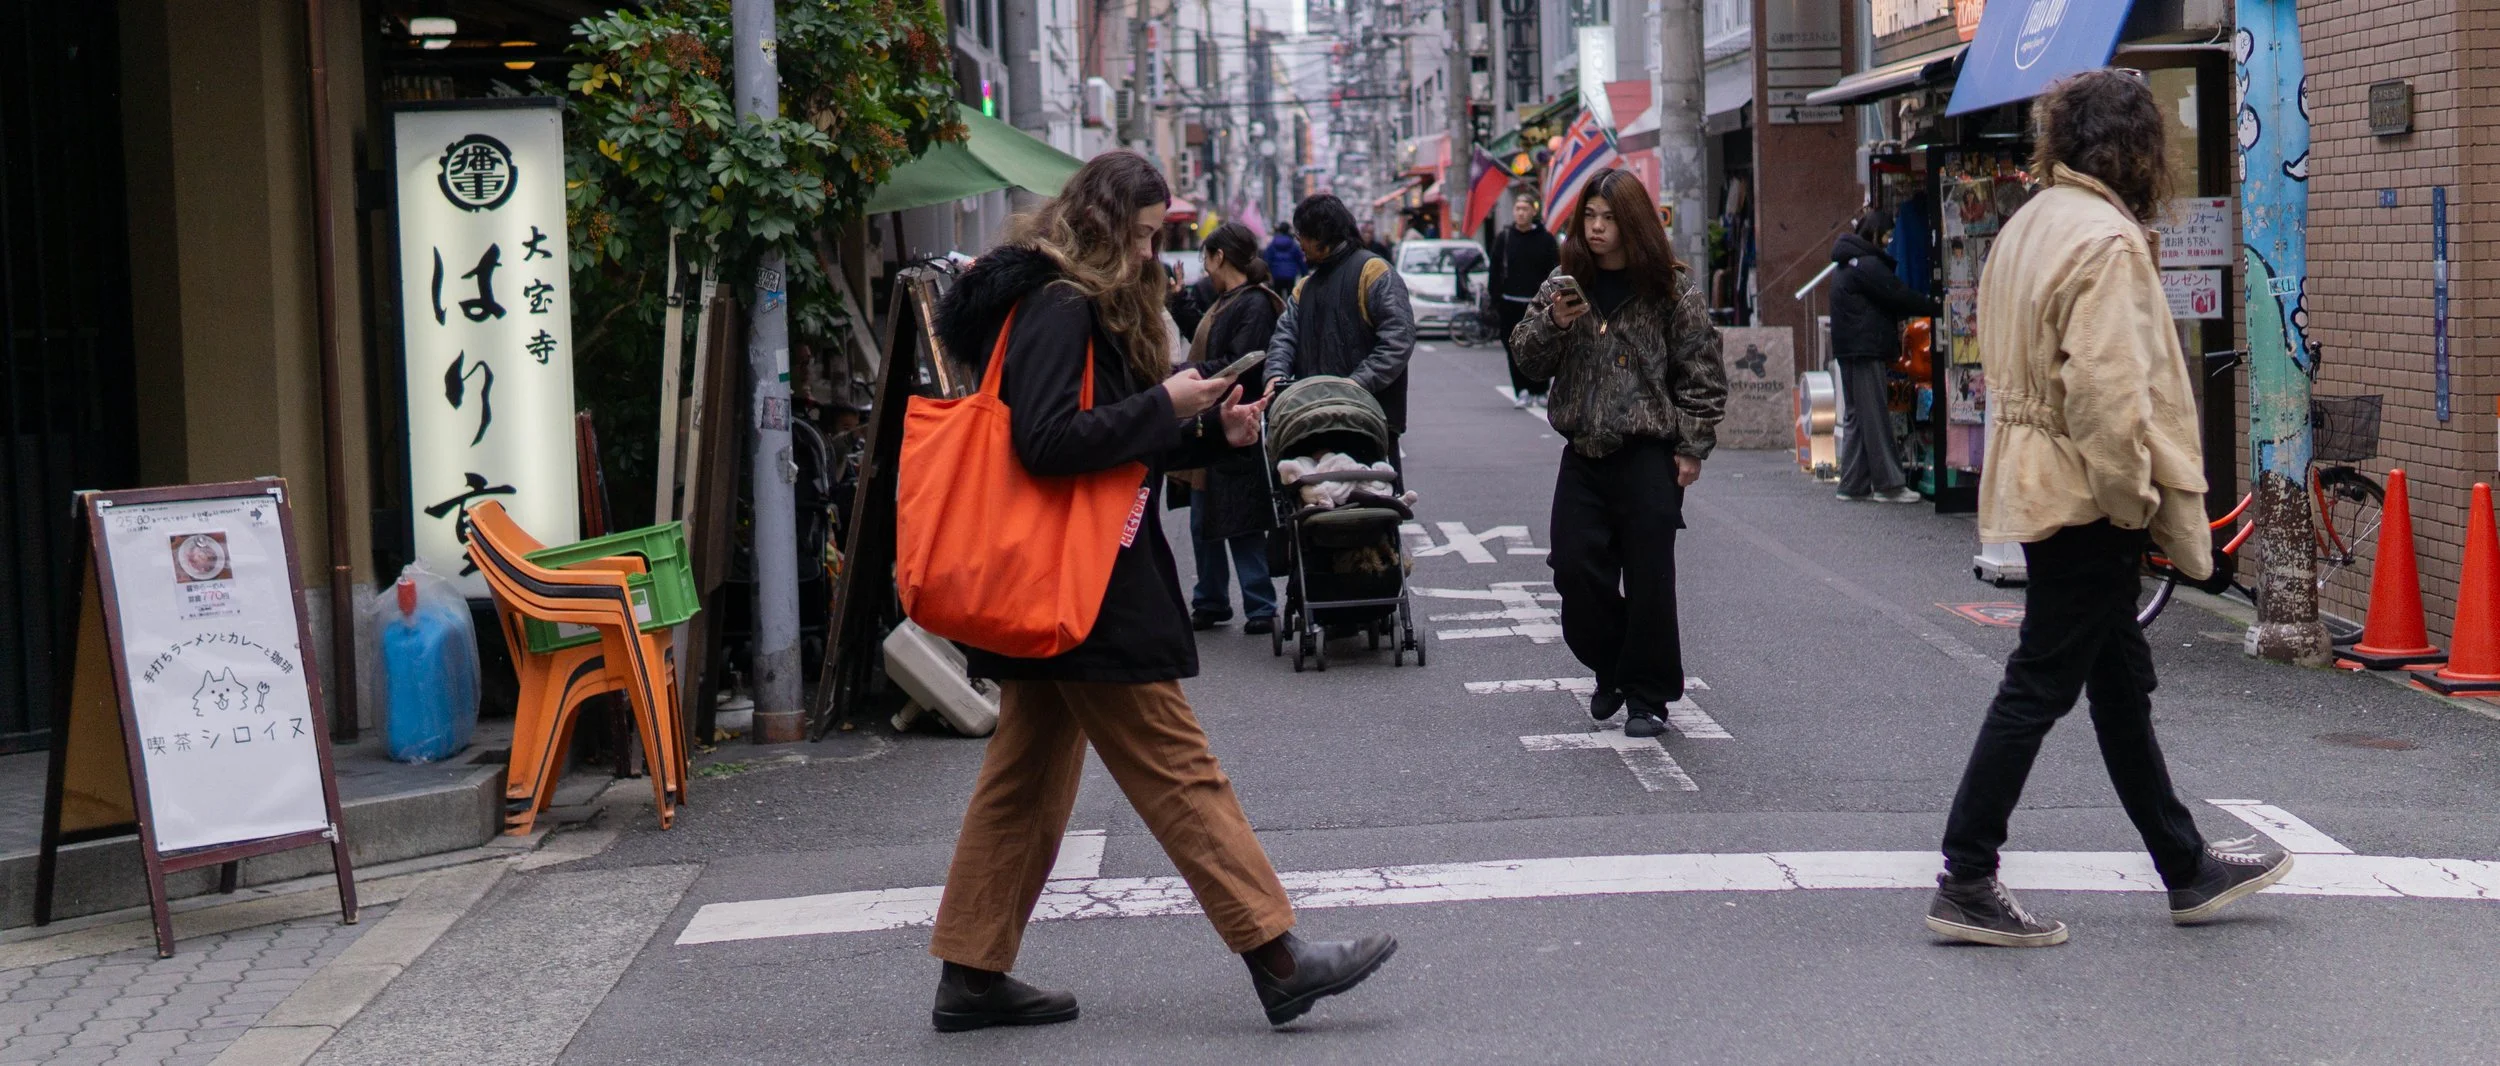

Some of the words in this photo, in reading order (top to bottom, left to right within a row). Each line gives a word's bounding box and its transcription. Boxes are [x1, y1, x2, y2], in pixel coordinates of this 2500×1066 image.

[522, 225, 558, 365] 大宝寺
[2162, 273, 2212, 286] プレゼント
[2439, 336, 2445, 354] 8
[143, 631, 294, 684] 手打ちラーメンとカレーと珈琲
[147, 717, 305, 756] 喫茶シロイヌ
